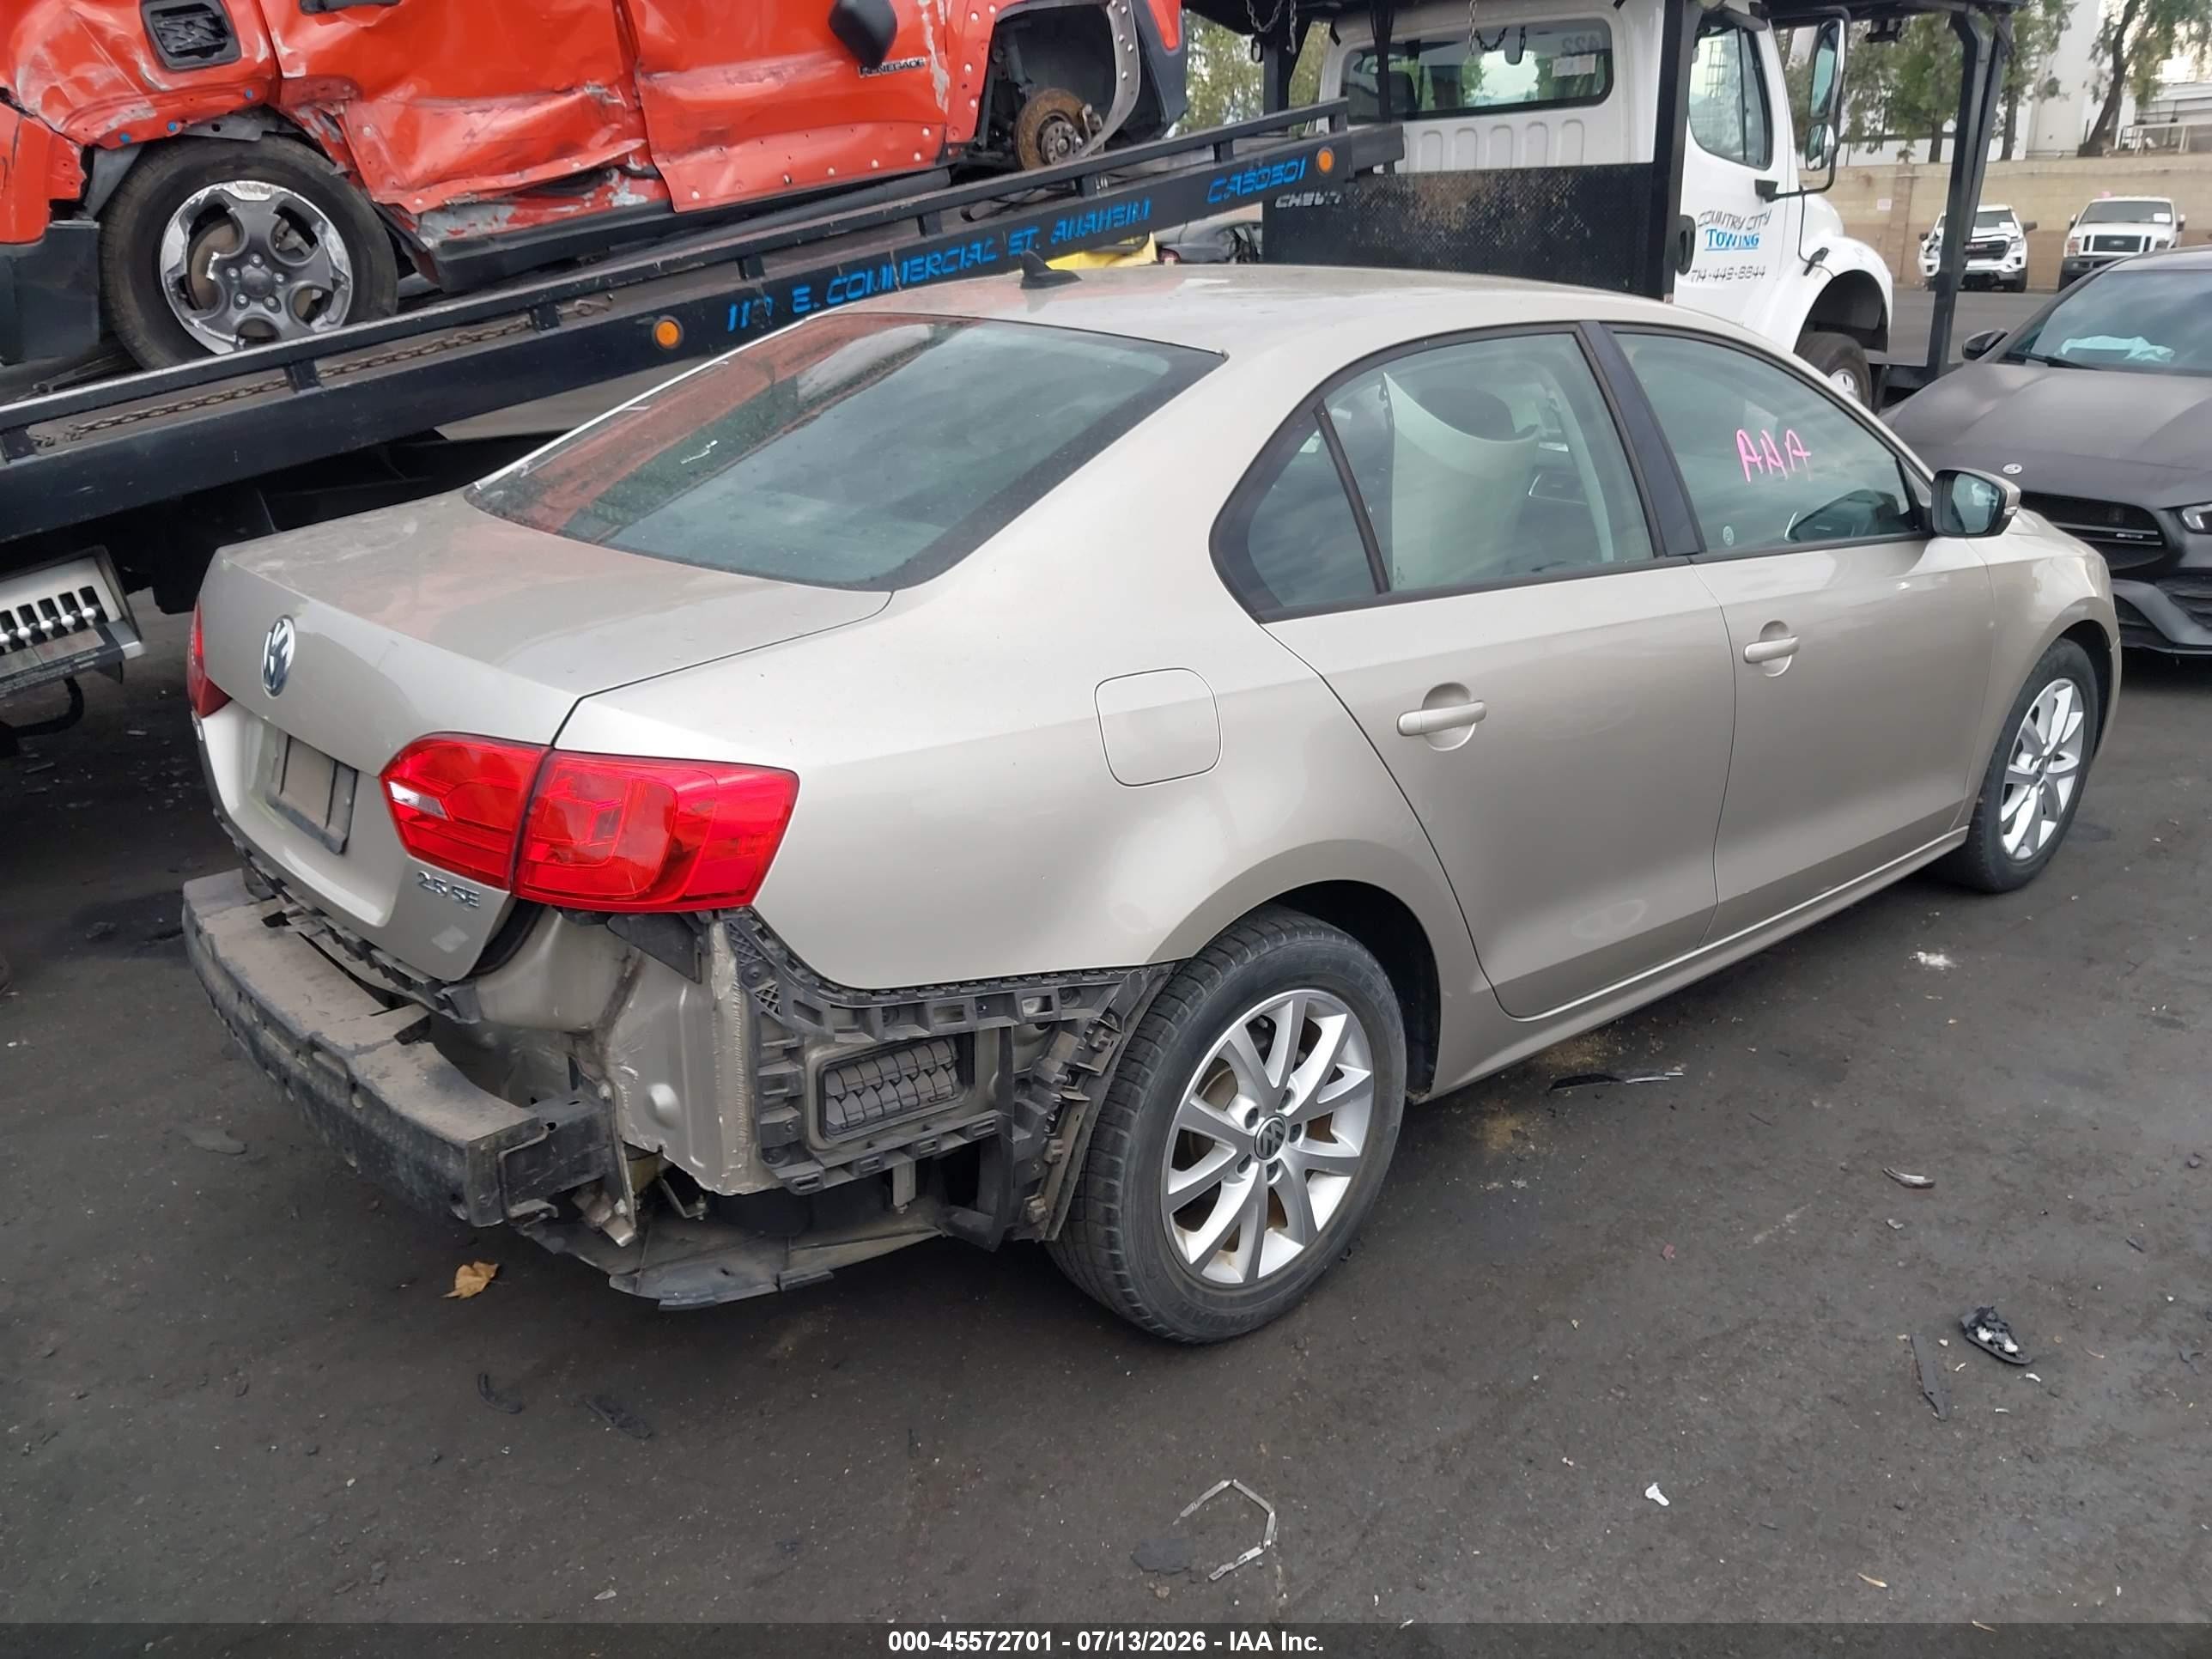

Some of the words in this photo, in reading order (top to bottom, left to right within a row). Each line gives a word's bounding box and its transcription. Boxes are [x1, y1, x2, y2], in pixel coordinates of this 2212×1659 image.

[1705, 228, 1759, 247] TOWING
[1747, 209, 1772, 230] CITY
[826, 236, 998, 305] COMMERCIAL
[1050, 197, 1152, 246] ANAHEIM
[1736, 428, 1812, 483] AAA
